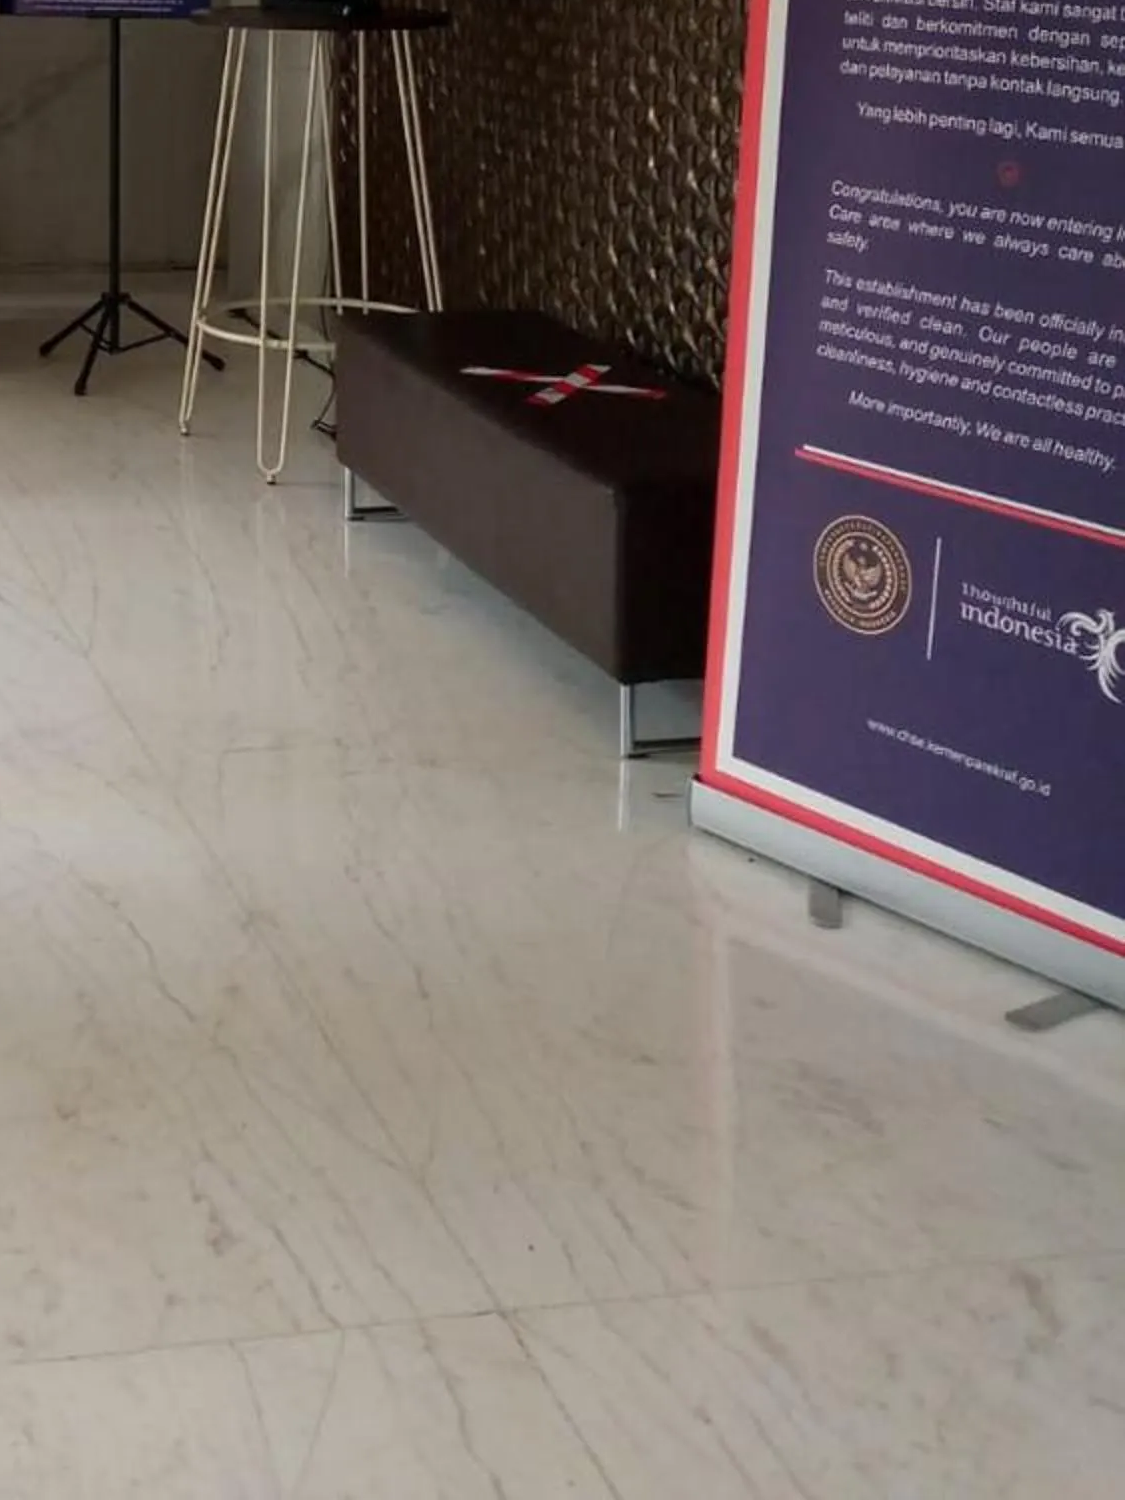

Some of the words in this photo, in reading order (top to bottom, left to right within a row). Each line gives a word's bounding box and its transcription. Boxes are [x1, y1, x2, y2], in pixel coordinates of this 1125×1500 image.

[882, 13, 907, 29] dan
[916, 16, 1018, 40] berkomitmen
[1028, 25, 1090, 49] dengan
[1063, 2, 1117, 23] sangat
[842, 36, 880, 53] untuk
[883, 41, 1006, 64] memprioritaskan
[840, 59, 867, 75] dan
[869, 63, 941, 86] pelayanan
[944, 71, 988, 96] tanpa
[990, 74, 1046, 97] kontak
[856, 101, 892, 124] Yang
[893, 105, 926, 125] lebih
[928, 112, 987, 137] penting
[1026, 121, 1066, 142] Kami
[1070, 128, 1124, 149] semua
[829, 204, 863, 225] Care
[869, 213, 901, 232] area
[909, 219, 954, 240] where
[963, 228, 986, 245] we
[994, 233, 1049, 258] always
[1058, 244, 1094, 264] care
[948, 199, 977, 218] you
[980, 205, 1007, 223] are
[1010, 210, 1045, 229] now
[1047, 216, 1113, 243] entering
[826, 269, 852, 289] This
[856, 276, 958, 311] establishment
[960, 297, 990, 317] has
[995, 302, 1035, 325] been
[822, 295, 848, 313] and
[857, 303, 912, 326] verified
[979, 324, 1010, 346] Our
[1018, 336, 1078, 361] people
[1087, 351, 1117, 369] are
[899, 335, 928, 355] and
[930, 343, 1005, 374] genuinely
[1008, 359, 1093, 390] committed
[1095, 376, 1111, 395] to
[899, 360, 959, 387] hygiene
[960, 376, 992, 397] and
[993, 382, 1083, 418] contactless
[848, 389, 886, 412] More
[975, 419, 1002, 442] We
[1003, 430, 1030, 449] are
[1032, 434, 1053, 454] all
